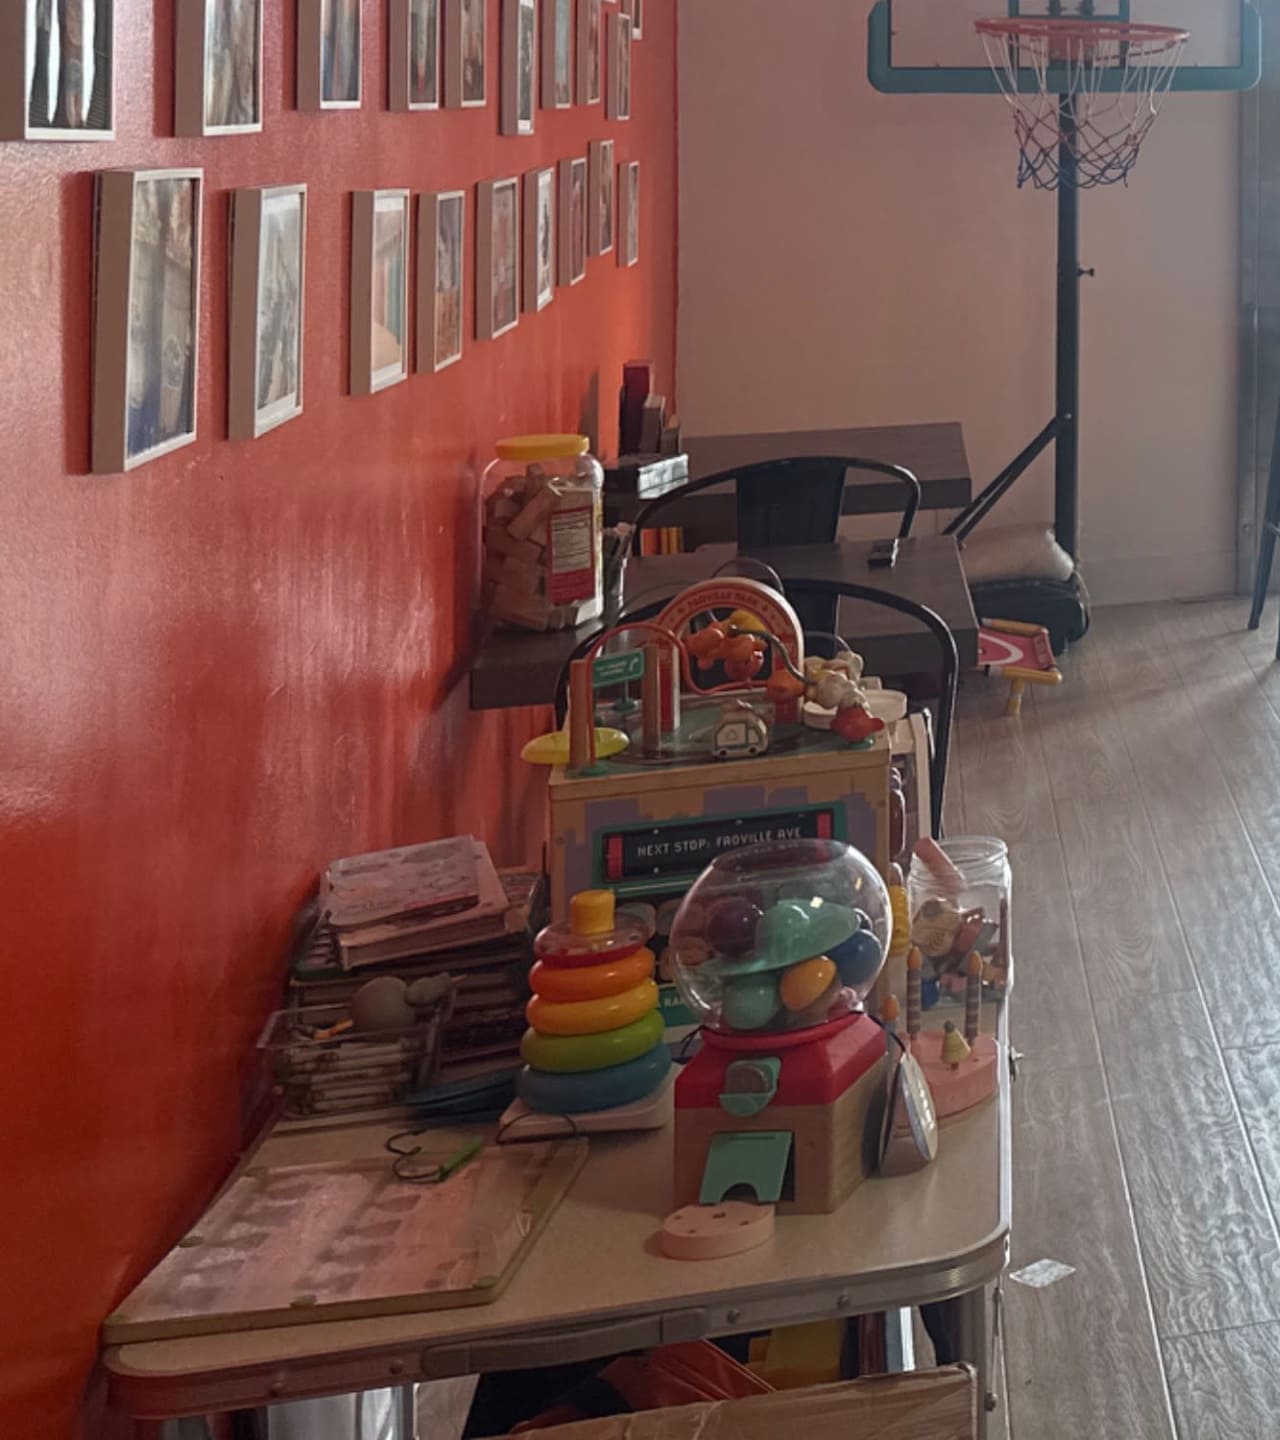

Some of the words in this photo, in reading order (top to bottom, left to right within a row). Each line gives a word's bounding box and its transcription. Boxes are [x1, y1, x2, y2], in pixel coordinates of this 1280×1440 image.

[636, 842, 672, 858] NEXT
[715, 831, 771, 848] FROVILLE
[777, 826, 802, 839] AVE
